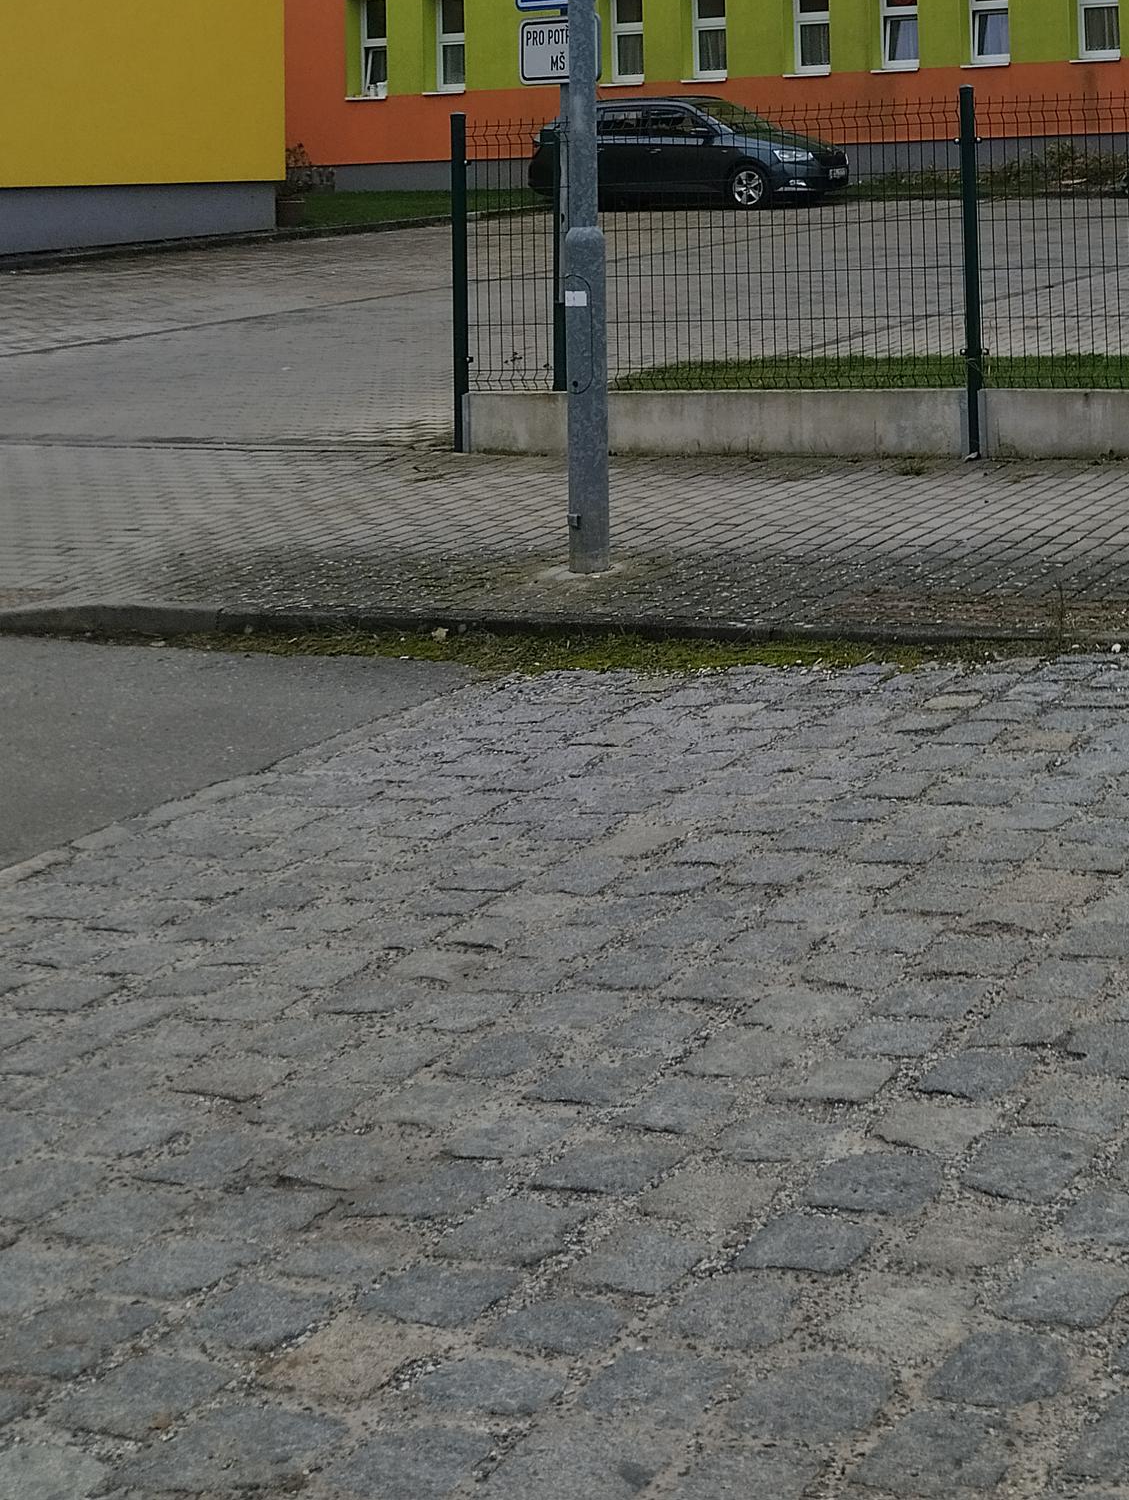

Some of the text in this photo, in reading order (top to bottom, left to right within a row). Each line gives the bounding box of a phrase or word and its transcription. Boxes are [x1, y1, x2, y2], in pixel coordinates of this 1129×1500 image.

[526, 24, 570, 46] PRO POTŘ
[550, 51, 566, 71] MŠ
